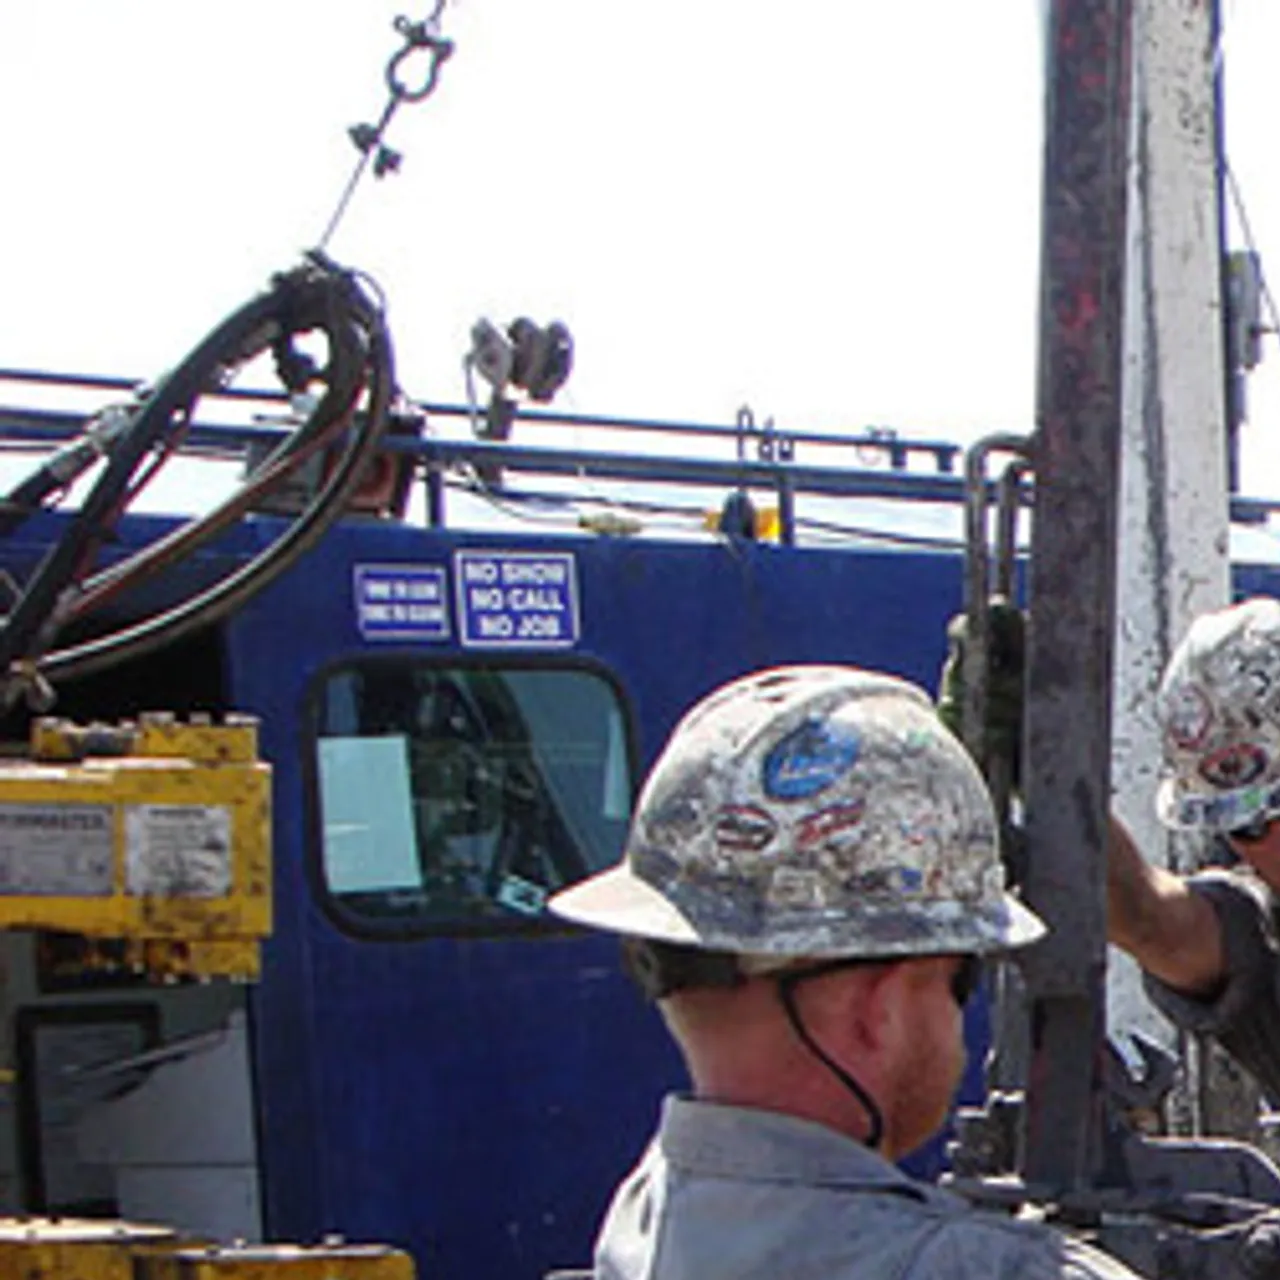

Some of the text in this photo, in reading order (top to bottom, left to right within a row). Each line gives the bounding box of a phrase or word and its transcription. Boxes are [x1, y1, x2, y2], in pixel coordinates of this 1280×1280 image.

[465, 562, 498, 583] NO
[470, 588, 565, 611] NO CALL
[480, 614, 560, 636] NO JOB
